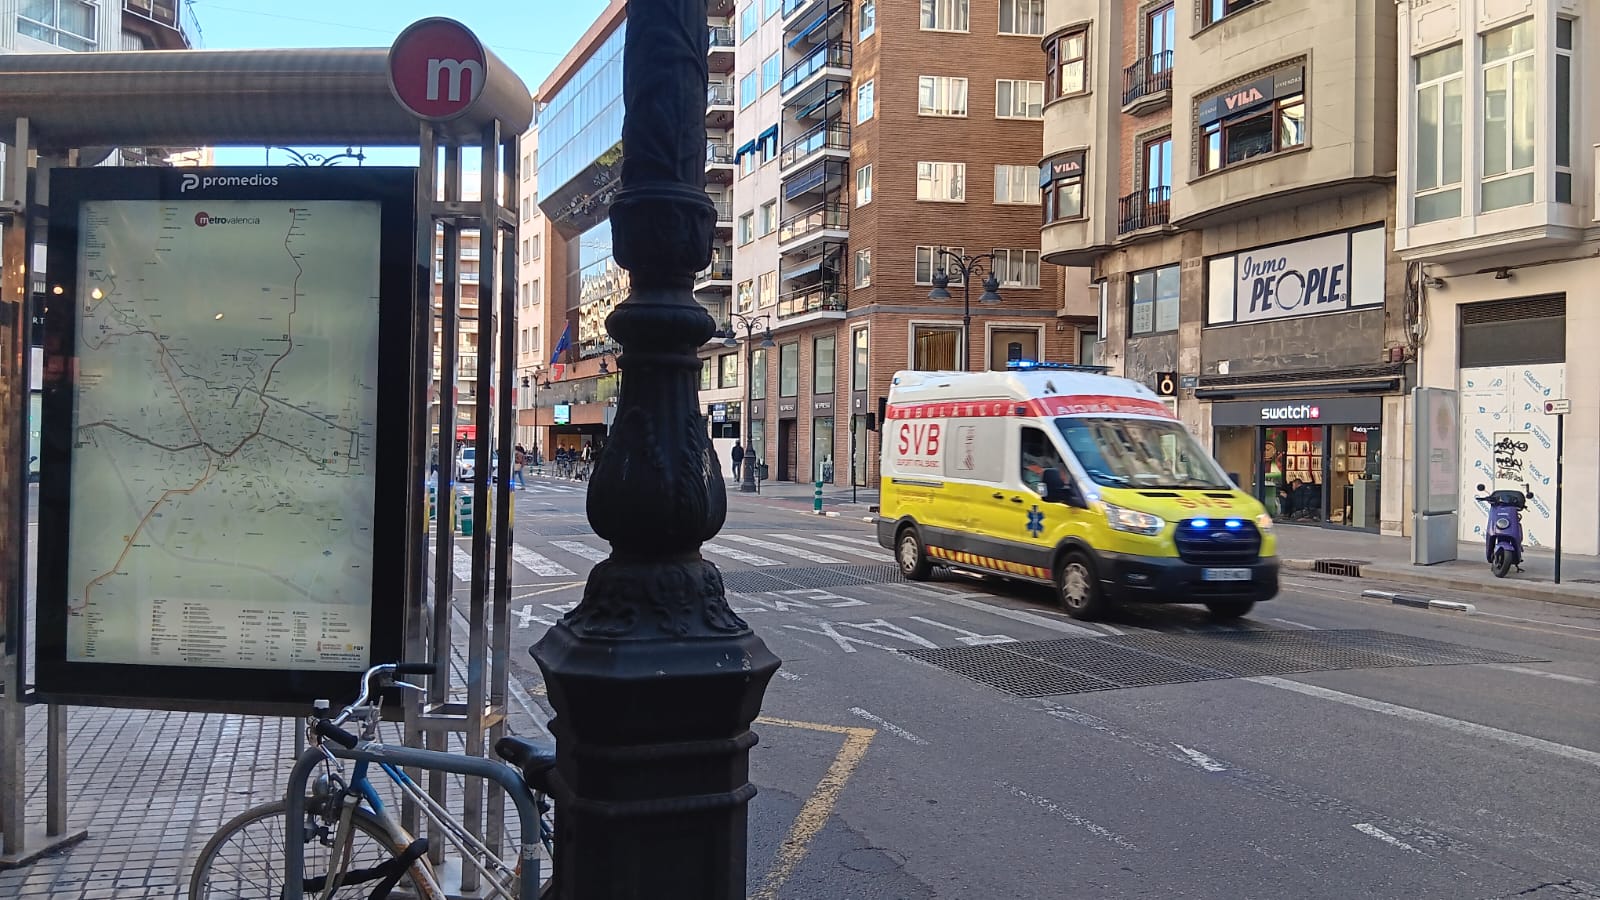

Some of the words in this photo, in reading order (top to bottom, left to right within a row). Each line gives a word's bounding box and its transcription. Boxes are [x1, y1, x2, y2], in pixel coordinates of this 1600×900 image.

[426, 58, 484, 101] m
[1225, 87, 1264, 110] VILA
[1053, 161, 1080, 173] VILA
[203, 173, 279, 189] promedios
[199, 215, 260, 225] metrovalencia
[1242, 255, 1287, 280] Inmo
[1261, 404, 1310, 419] swatch
[898, 423, 941, 456] SVB
